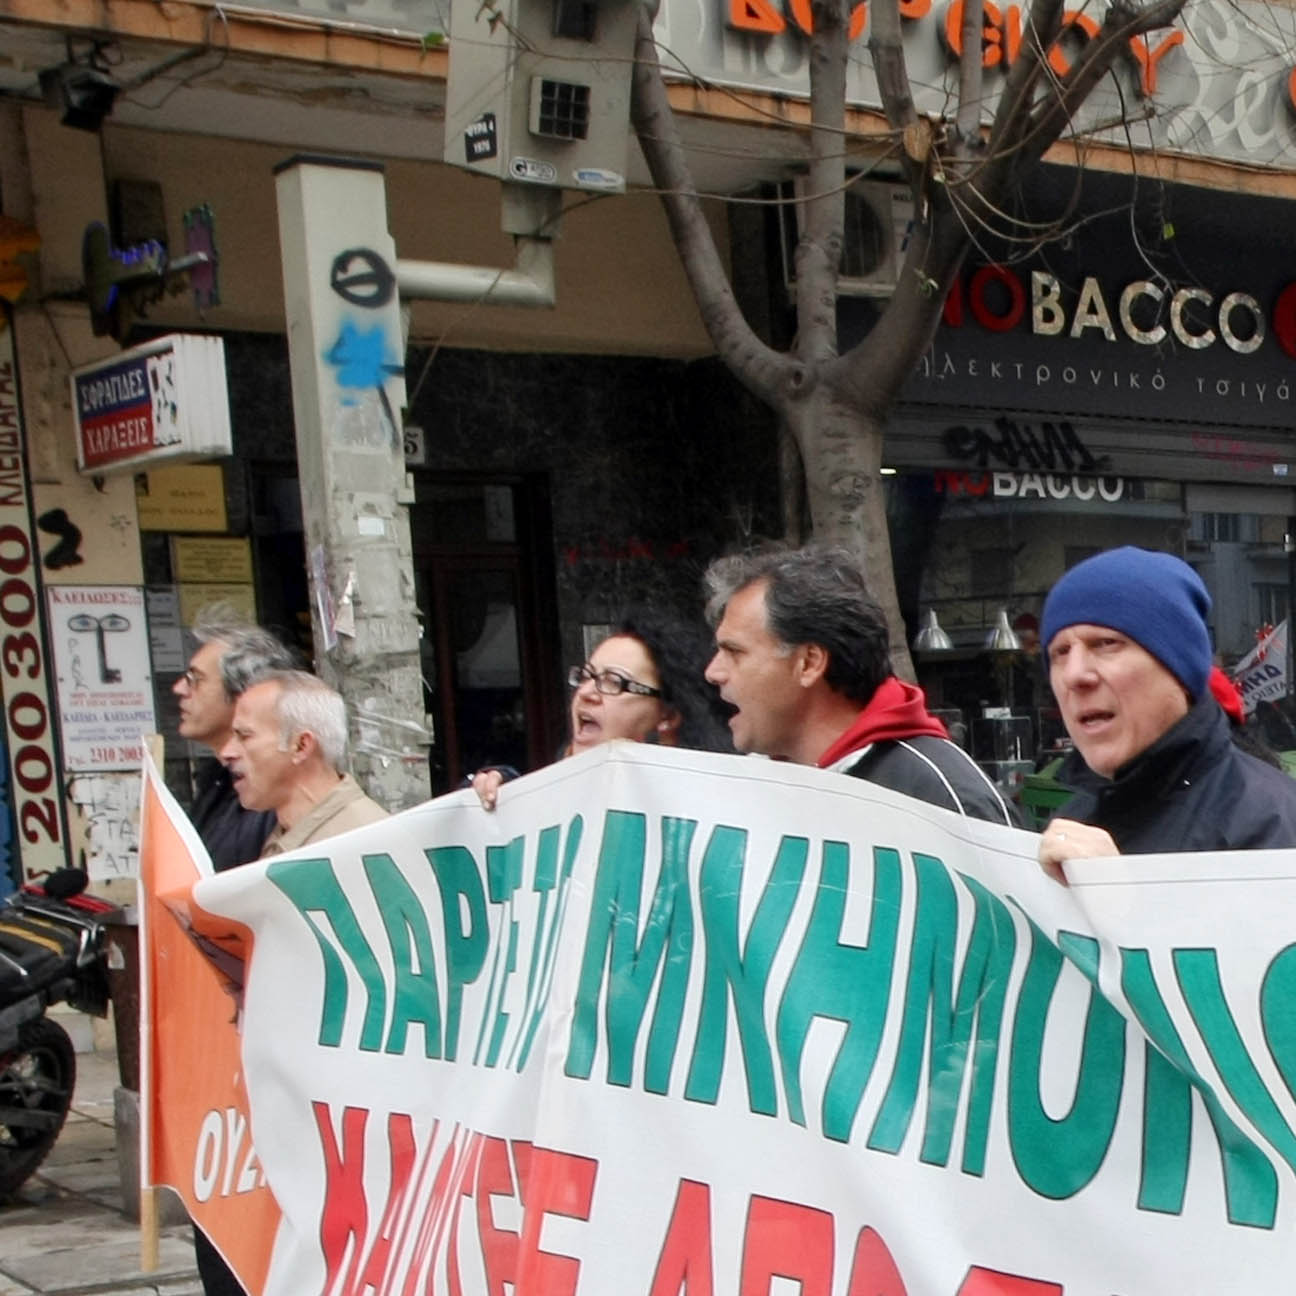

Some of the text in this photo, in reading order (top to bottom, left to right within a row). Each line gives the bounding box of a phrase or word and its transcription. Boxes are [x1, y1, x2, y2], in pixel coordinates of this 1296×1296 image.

[80, 368, 147, 412] ΣΦΡΑΓΙΔΕΣ
[86, 416, 150, 454] ΧΑΡΑΞΕΙΣ
[90, 748, 116, 763] 2310
[119, 747, 144, 762] 2003
